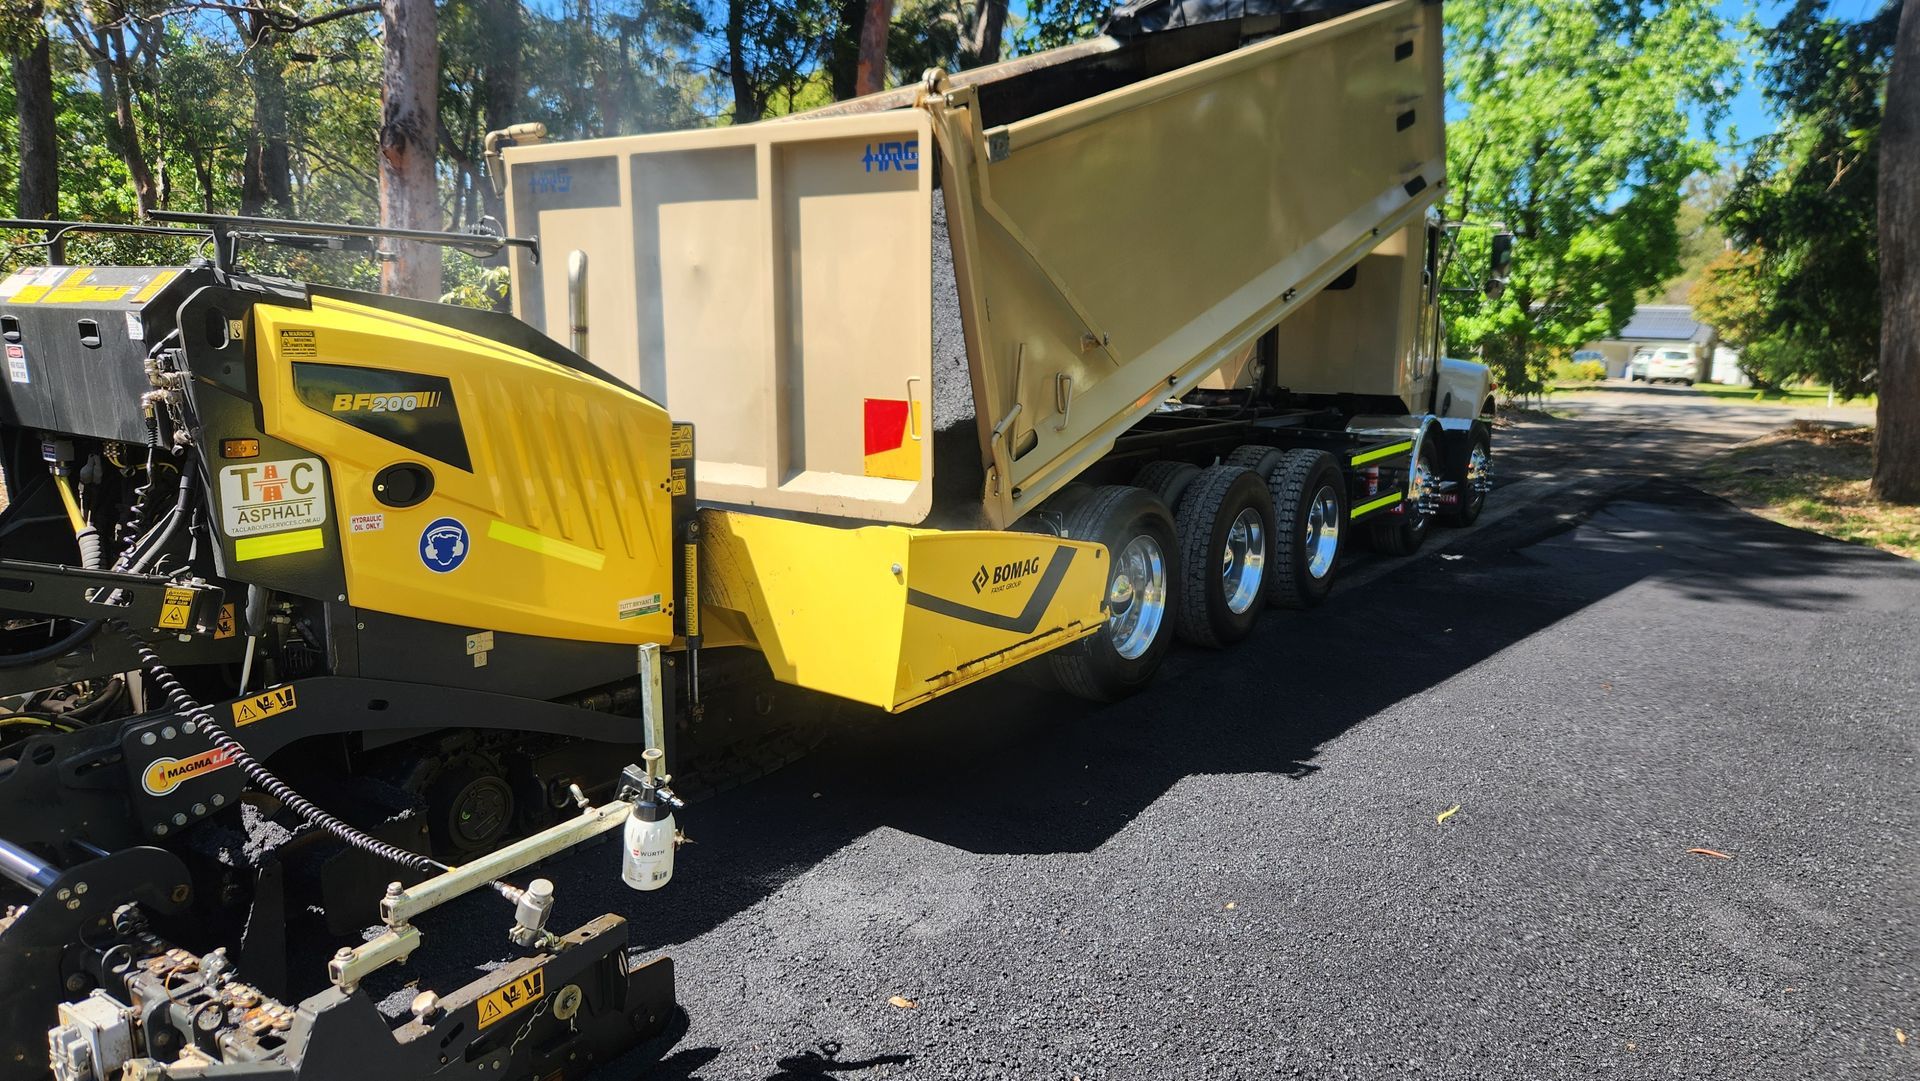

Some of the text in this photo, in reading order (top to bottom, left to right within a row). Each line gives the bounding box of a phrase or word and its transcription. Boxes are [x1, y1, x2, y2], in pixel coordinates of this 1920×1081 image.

[238, 503, 313, 525] ASPHALT
[352, 514, 382, 524] HYDRAULIC
[232, 517, 321, 534] TACLABOURSERVICES.COM.AU
[365, 522, 380, 530] ONLY
[992, 556, 1040, 585] BOMAG
[1005, 580, 1022, 590] GROUP
